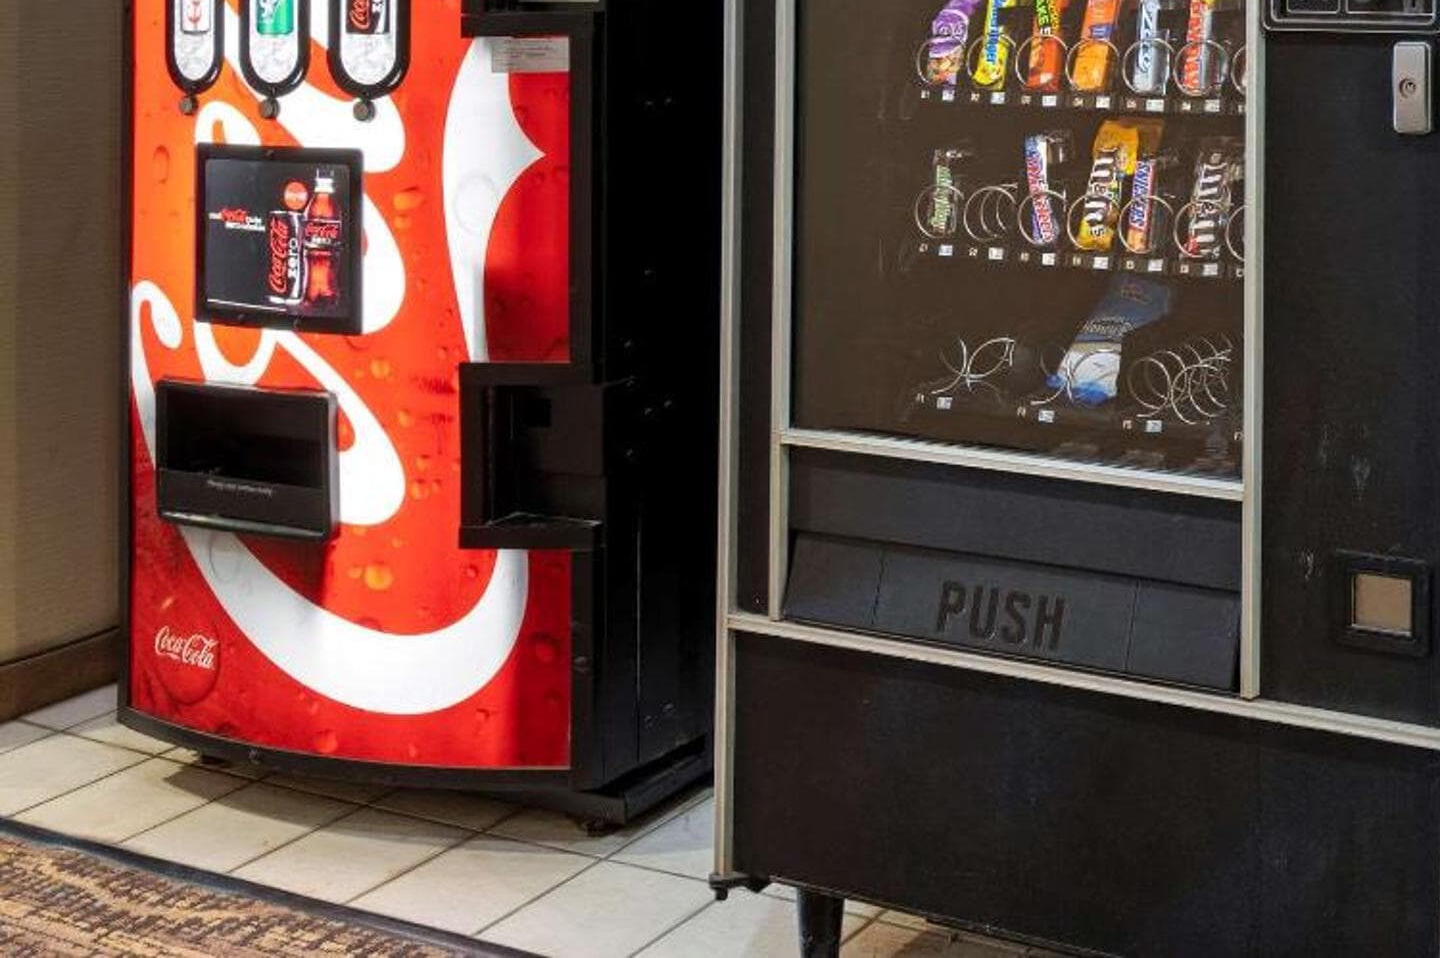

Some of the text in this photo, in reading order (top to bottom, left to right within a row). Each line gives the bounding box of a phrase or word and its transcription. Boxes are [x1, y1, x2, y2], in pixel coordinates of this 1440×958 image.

[287, 238, 300, 279] zero
[936, 580, 1067, 652] PUSH
[154, 625, 219, 671] Coca-Cola
